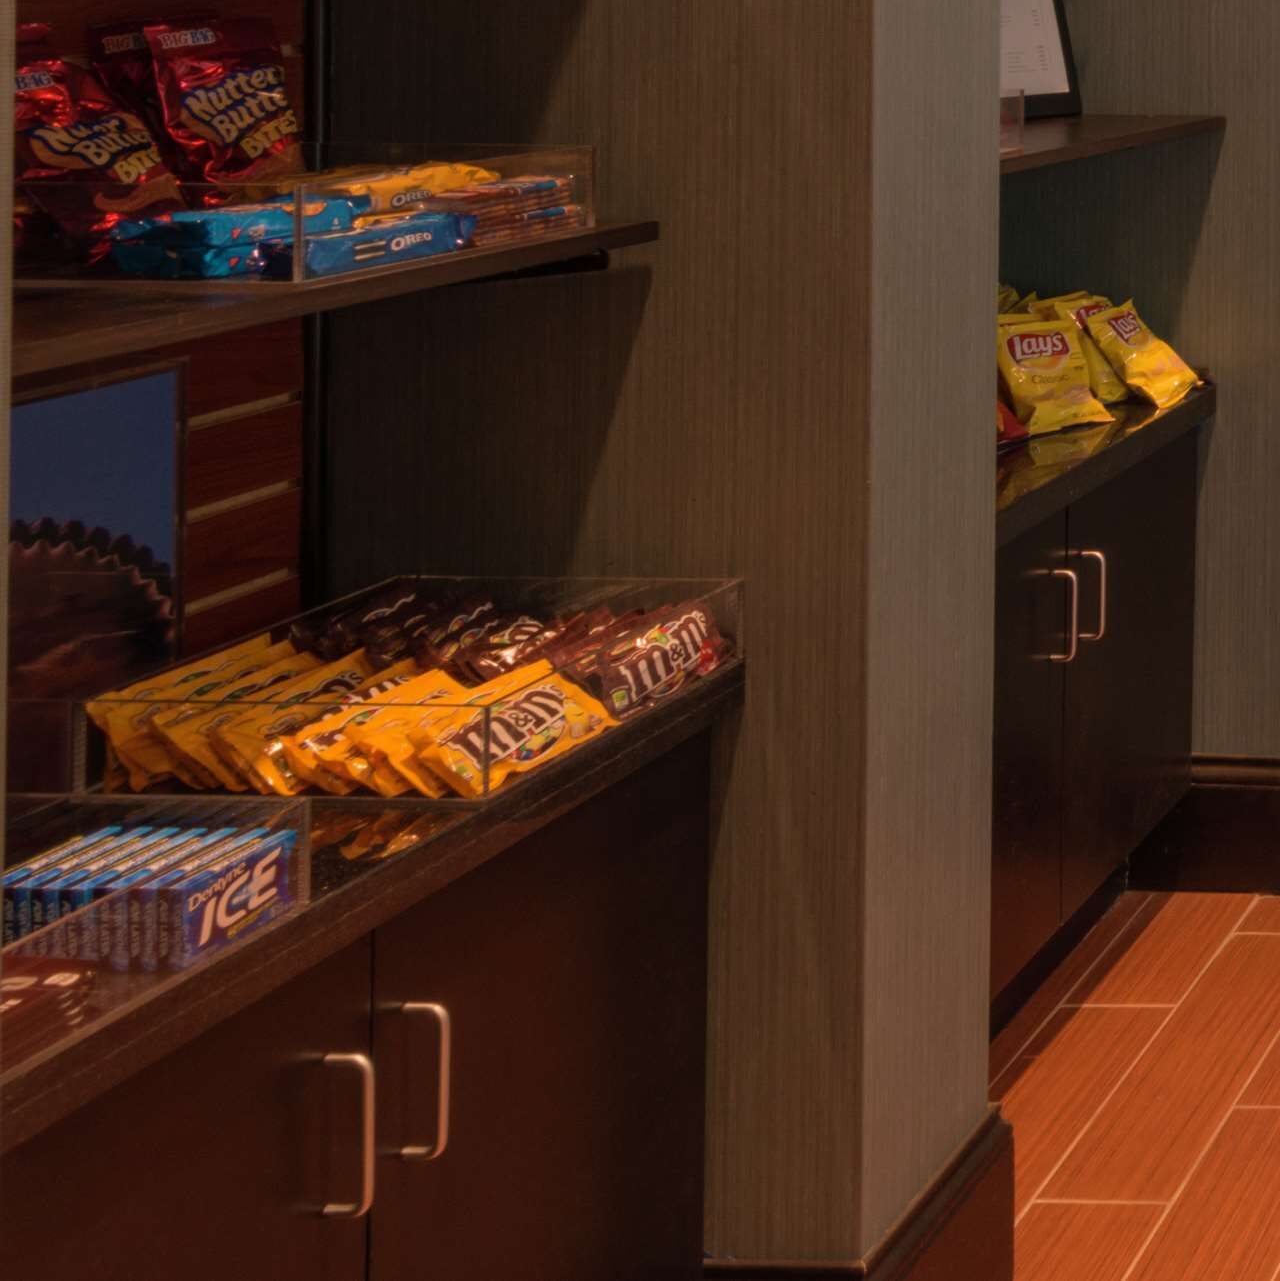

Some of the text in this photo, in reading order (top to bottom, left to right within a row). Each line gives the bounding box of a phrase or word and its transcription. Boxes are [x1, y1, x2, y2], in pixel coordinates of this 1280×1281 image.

[184, 68, 281, 121] Nutter
[210, 89, 288, 144] Butte
[391, 190, 432, 207] OREO
[390, 231, 432, 251] OREO
[198, 846, 283, 948] ICE
